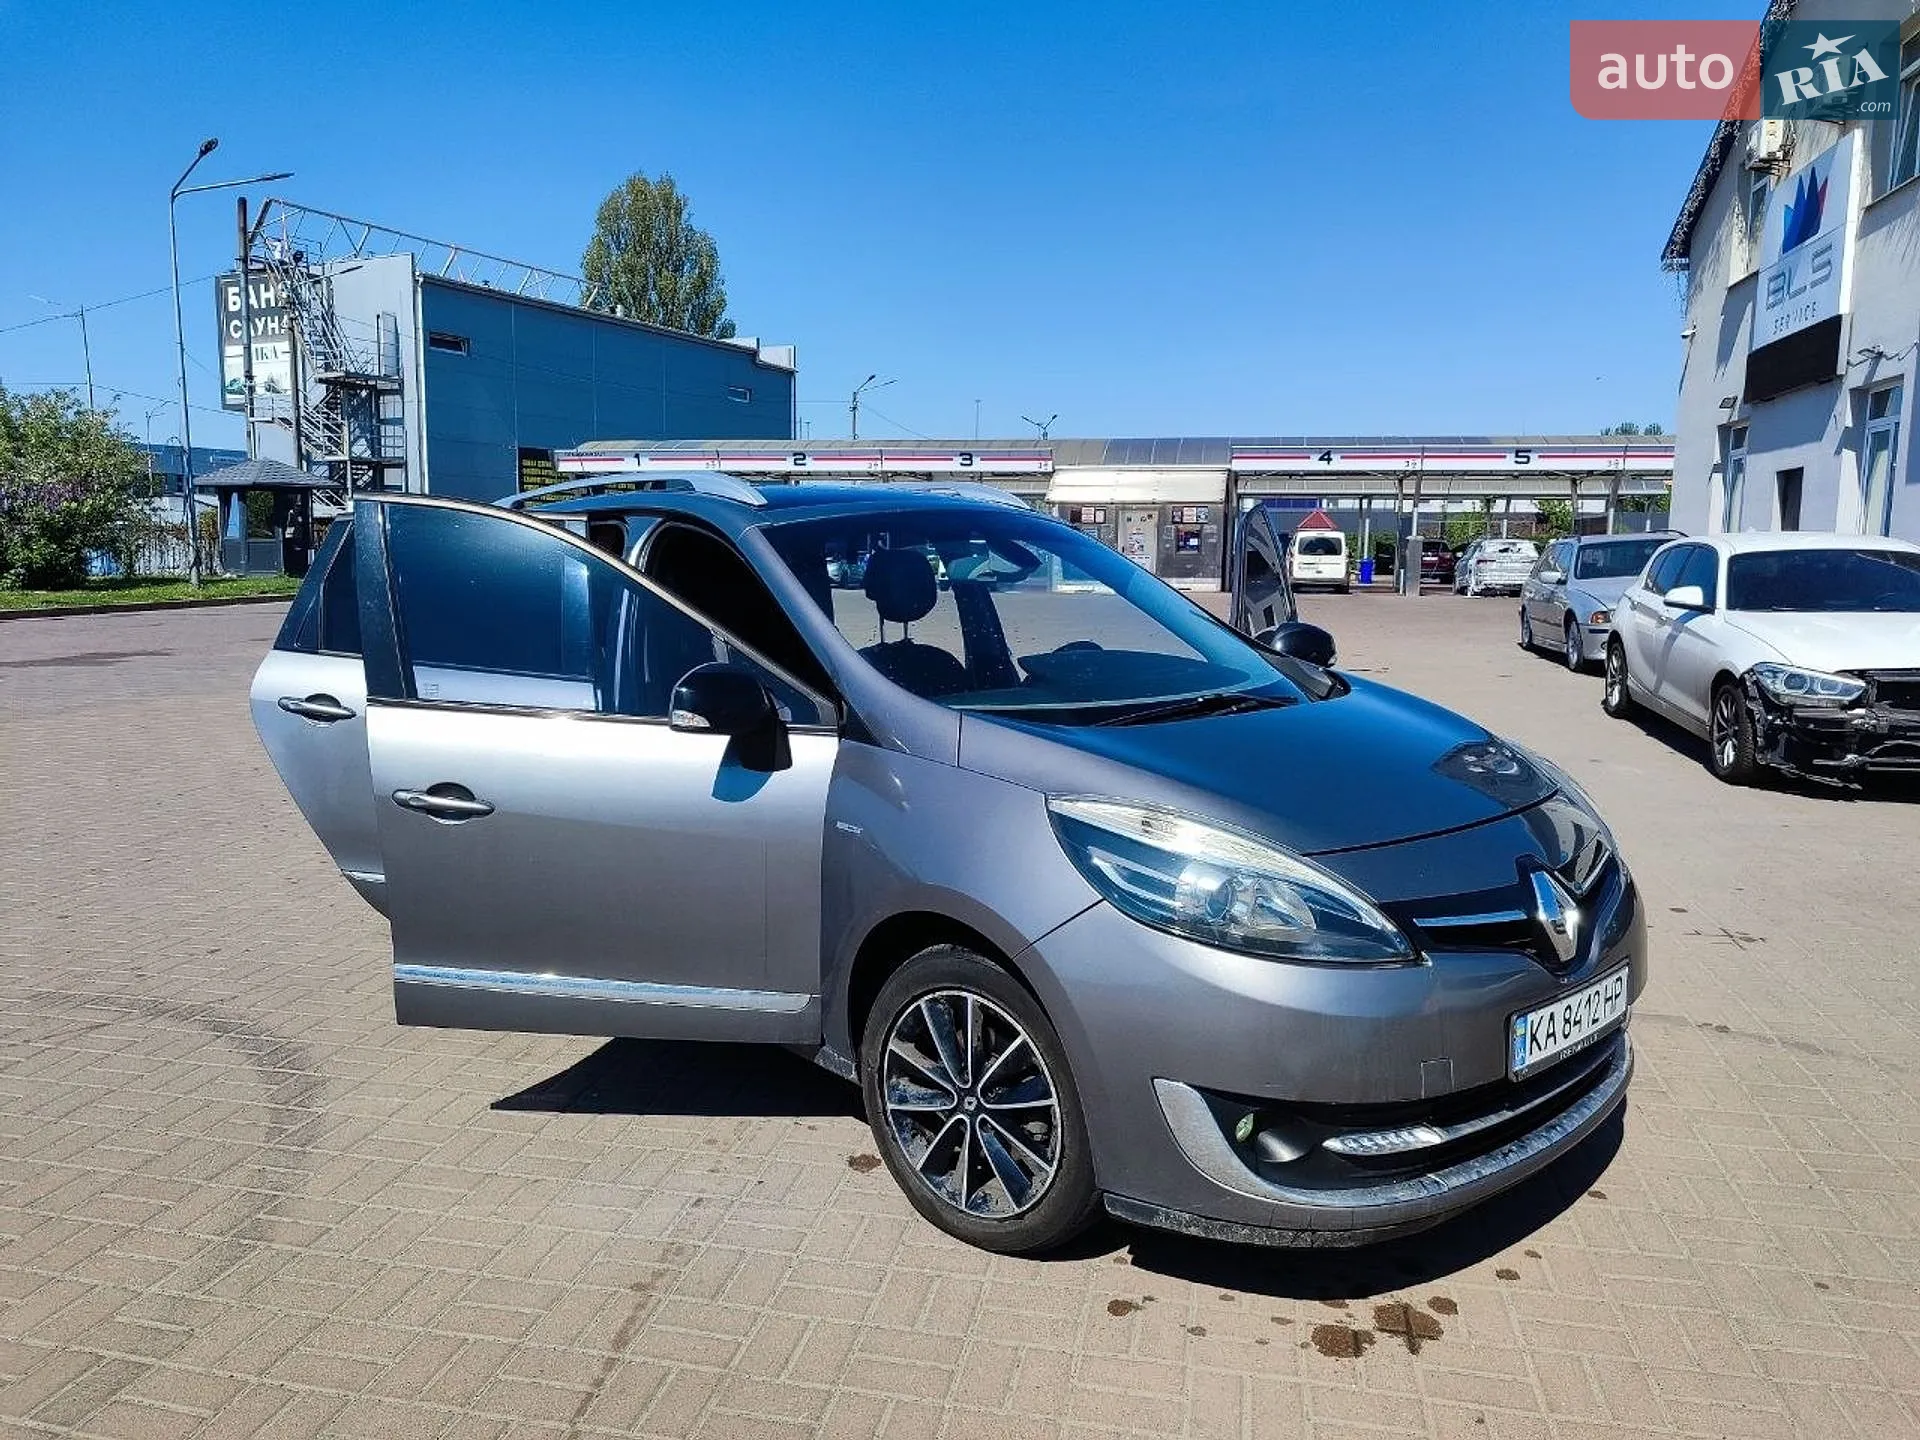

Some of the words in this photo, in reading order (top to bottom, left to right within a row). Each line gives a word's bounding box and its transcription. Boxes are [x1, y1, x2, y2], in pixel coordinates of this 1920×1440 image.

[1772, 301, 1817, 335] SERVICE
[634, 453, 641, 467] 1
[793, 452, 807, 466] 2
[959, 453, 974, 466] 3
[1318, 450, 1333, 465] 4
[1514, 450, 1532, 464] 5
[1528, 1011, 1557, 1055] KA
[1562, 990, 1600, 1039] 8412
[1603, 975, 1623, 1018] HP
